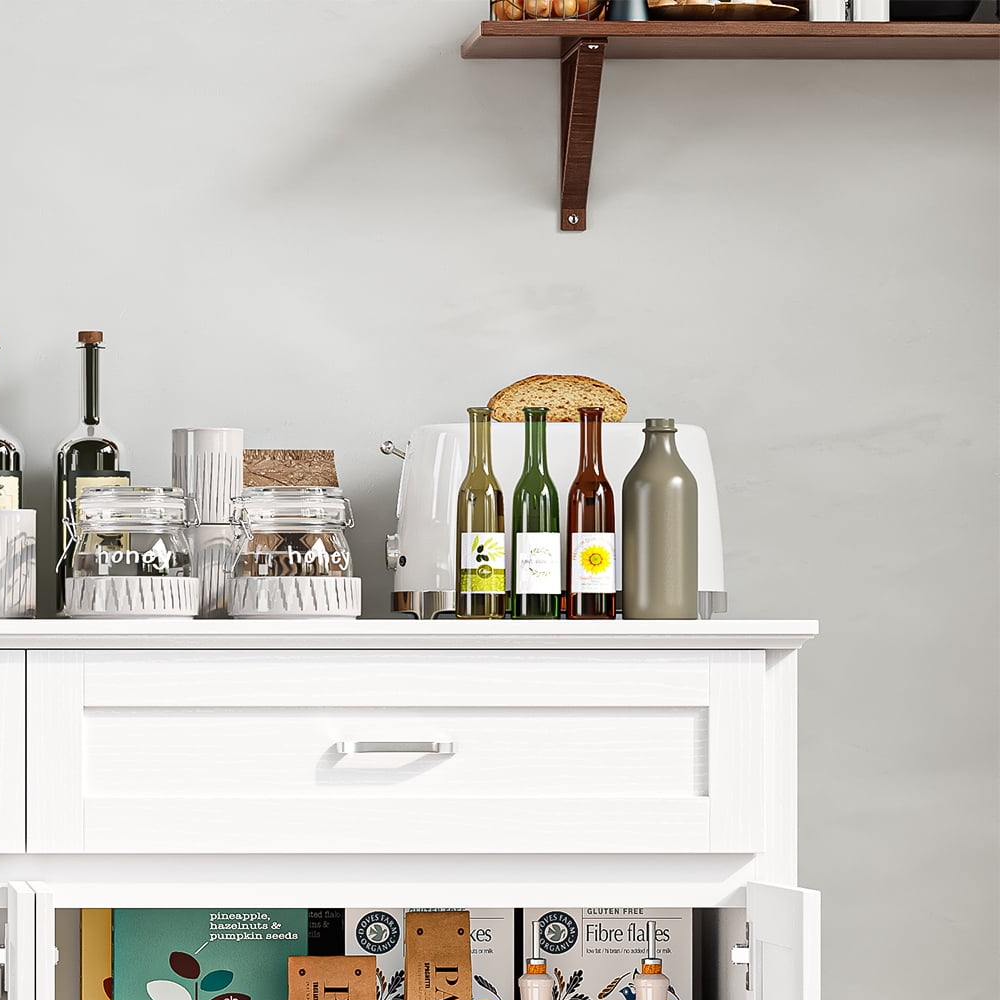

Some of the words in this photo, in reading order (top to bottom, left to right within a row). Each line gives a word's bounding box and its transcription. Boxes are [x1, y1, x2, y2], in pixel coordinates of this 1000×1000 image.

[209, 911, 271, 921] pineapple,
[209, 922, 268, 930] hazelnuts
[271, 922, 281, 930] &
[358, 913, 379, 935] DOVES
[380, 913, 398, 935] FARM
[209, 932, 263, 941] pumpkin
[266, 932, 298, 940] seeds
[586, 923, 624, 942] Fibre
[360, 937, 397, 953] ORGANIC
